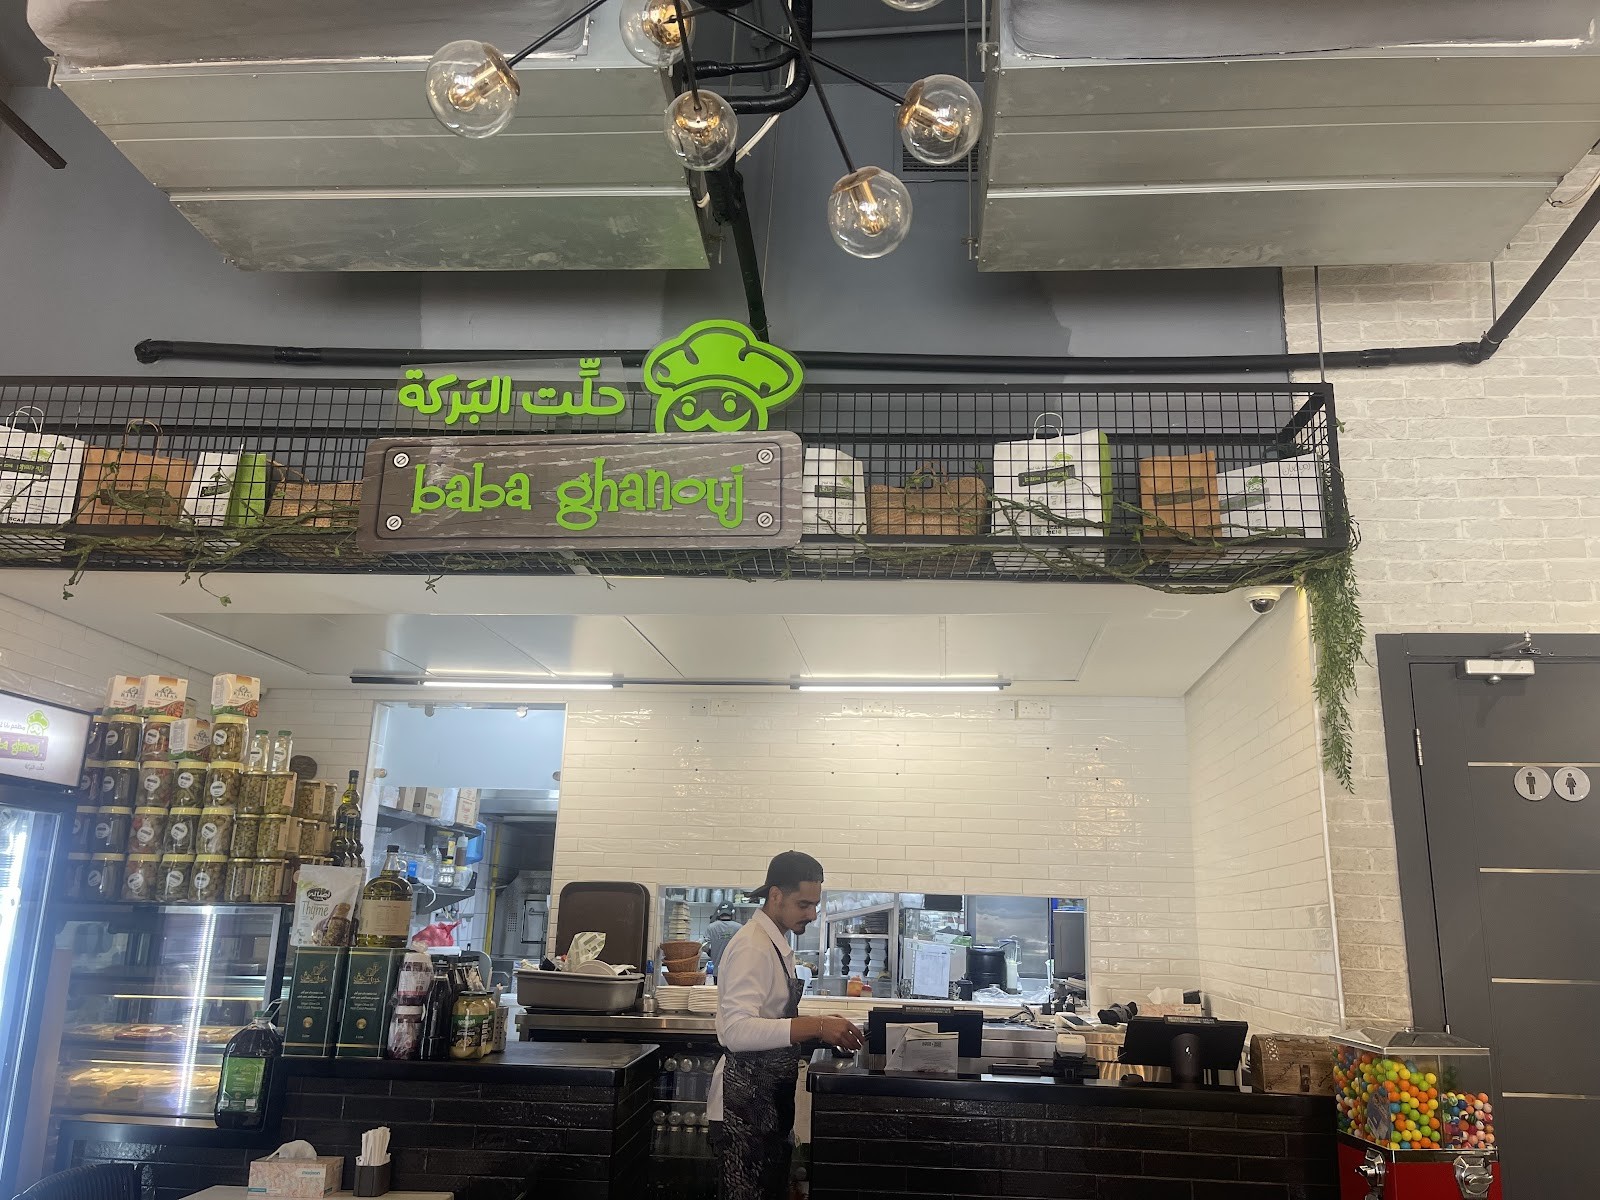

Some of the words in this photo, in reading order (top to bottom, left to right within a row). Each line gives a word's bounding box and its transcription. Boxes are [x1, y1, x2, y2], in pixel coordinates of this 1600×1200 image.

[410, 462, 532, 513] baba
[556, 457, 744, 530] ghanouj
[302, 901, 329, 920] Thyme
